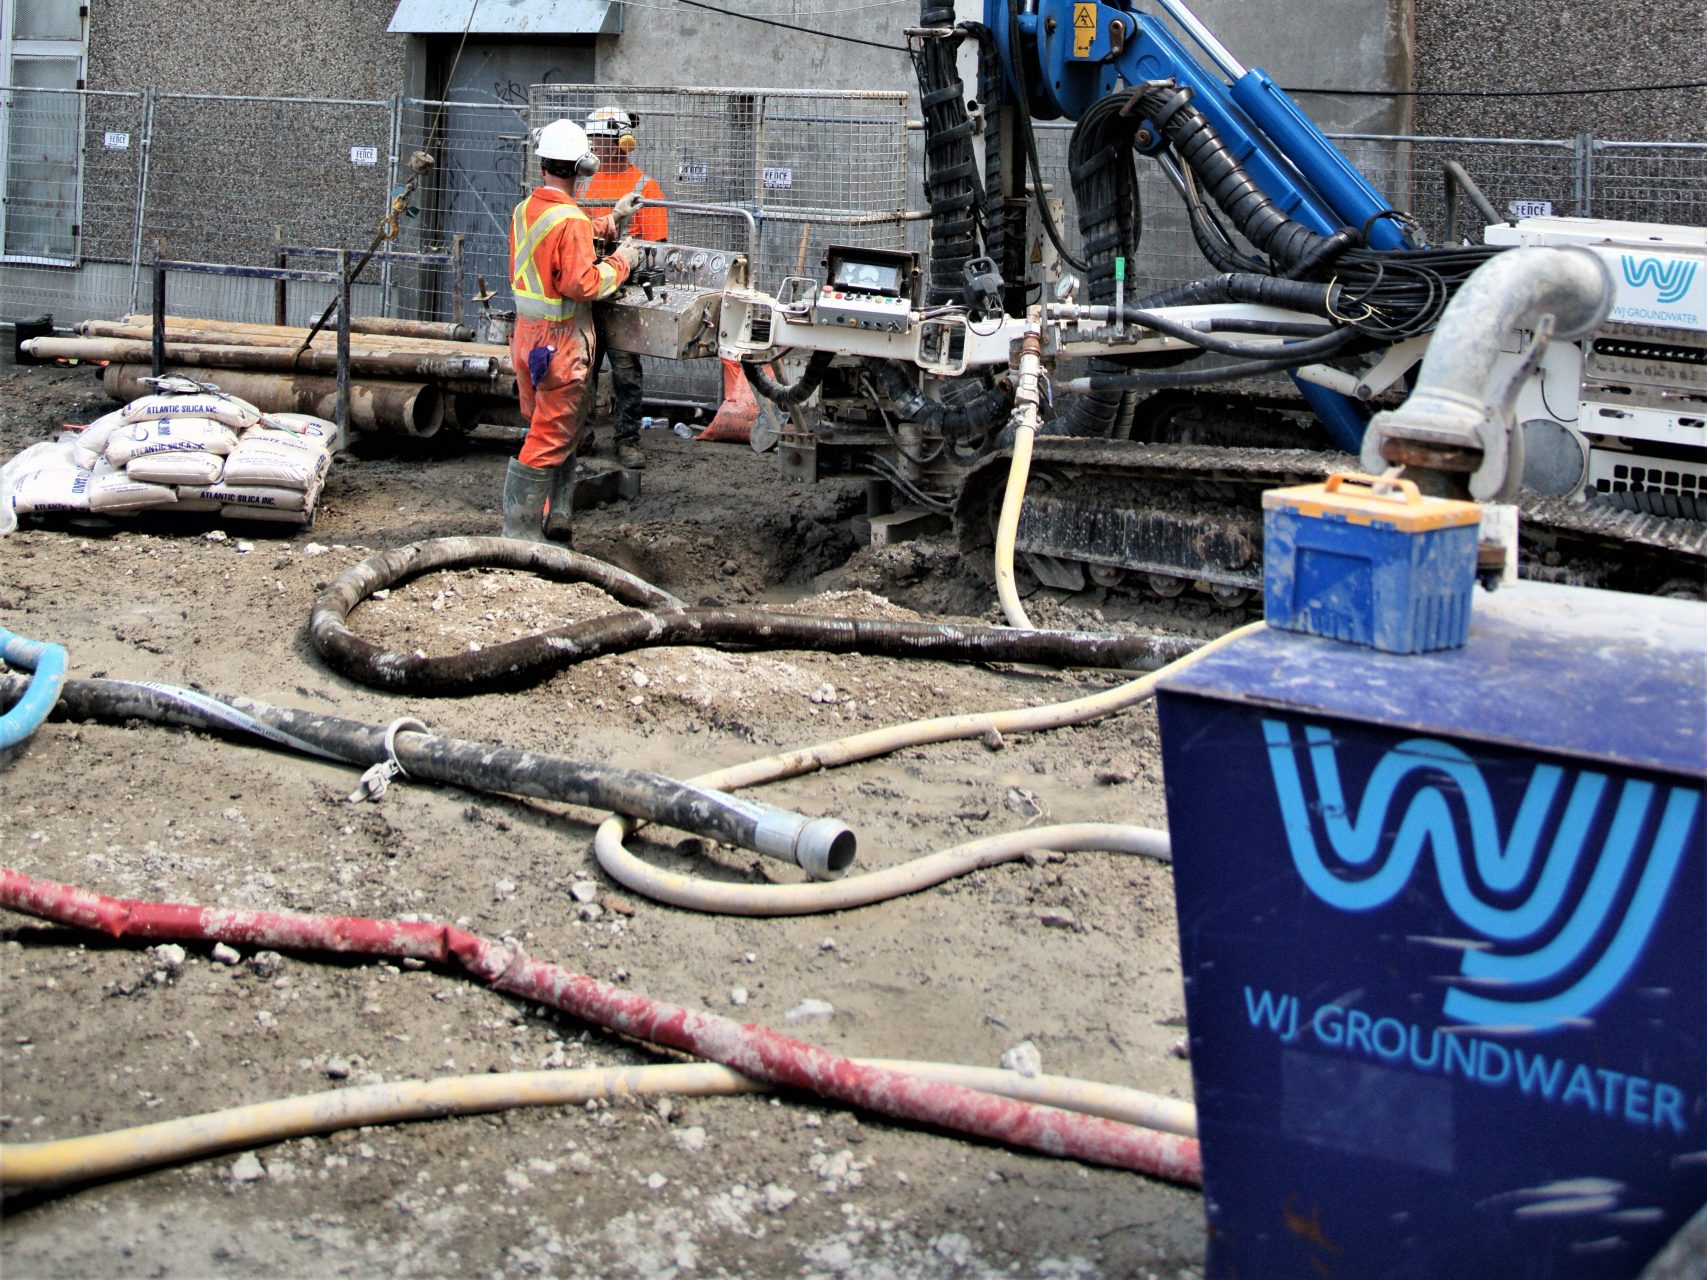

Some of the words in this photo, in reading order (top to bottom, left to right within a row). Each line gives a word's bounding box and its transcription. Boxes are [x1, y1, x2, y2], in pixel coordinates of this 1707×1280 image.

[110, 135, 126, 144] FENCE
[356, 150, 373, 159] FENCE
[765, 171, 788, 180] FENCE
[1516, 204, 1545, 216] FENCE
[1627, 307, 1698, 324] GROUNDWATER
[146, 405, 180, 415] ATLANTIC
[181, 405, 204, 413] SILICA
[130, 443, 166, 457] ATLANTIC
[200, 491, 236, 502] ATLANTIC
[237, 494, 261, 504] SILICA
[1243, 985, 1299, 1043] WJ
[1312, 1003, 1687, 1135] GROUNDWATER
